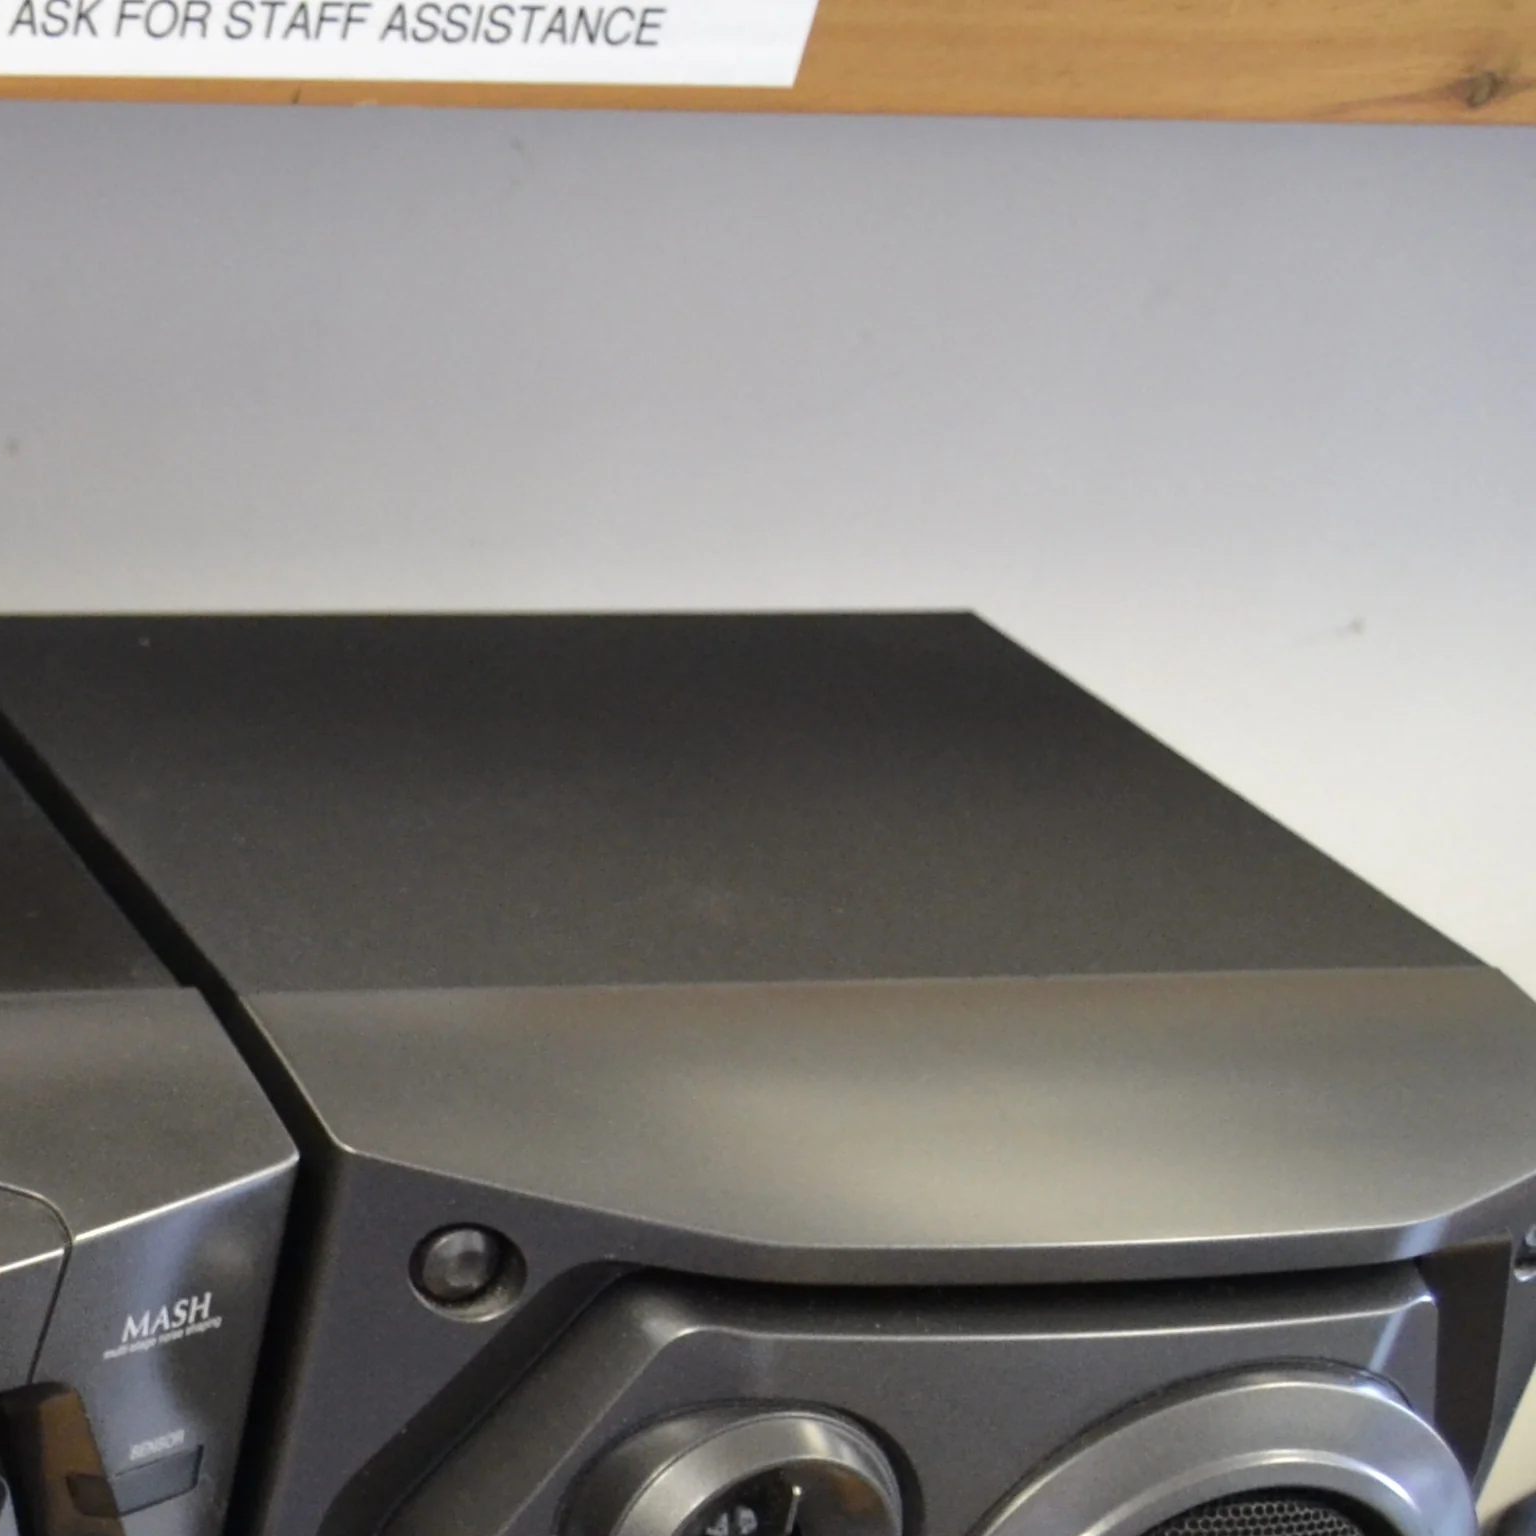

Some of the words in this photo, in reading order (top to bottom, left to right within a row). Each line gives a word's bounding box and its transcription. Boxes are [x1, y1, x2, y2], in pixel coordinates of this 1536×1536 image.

[8, 0, 102, 37] ASK
[114, 0, 212, 39] FOR
[224, 0, 372, 40] STAFF
[380, 3, 666, 46] ASSISTANCE
[121, 1291, 212, 1343] MASH
